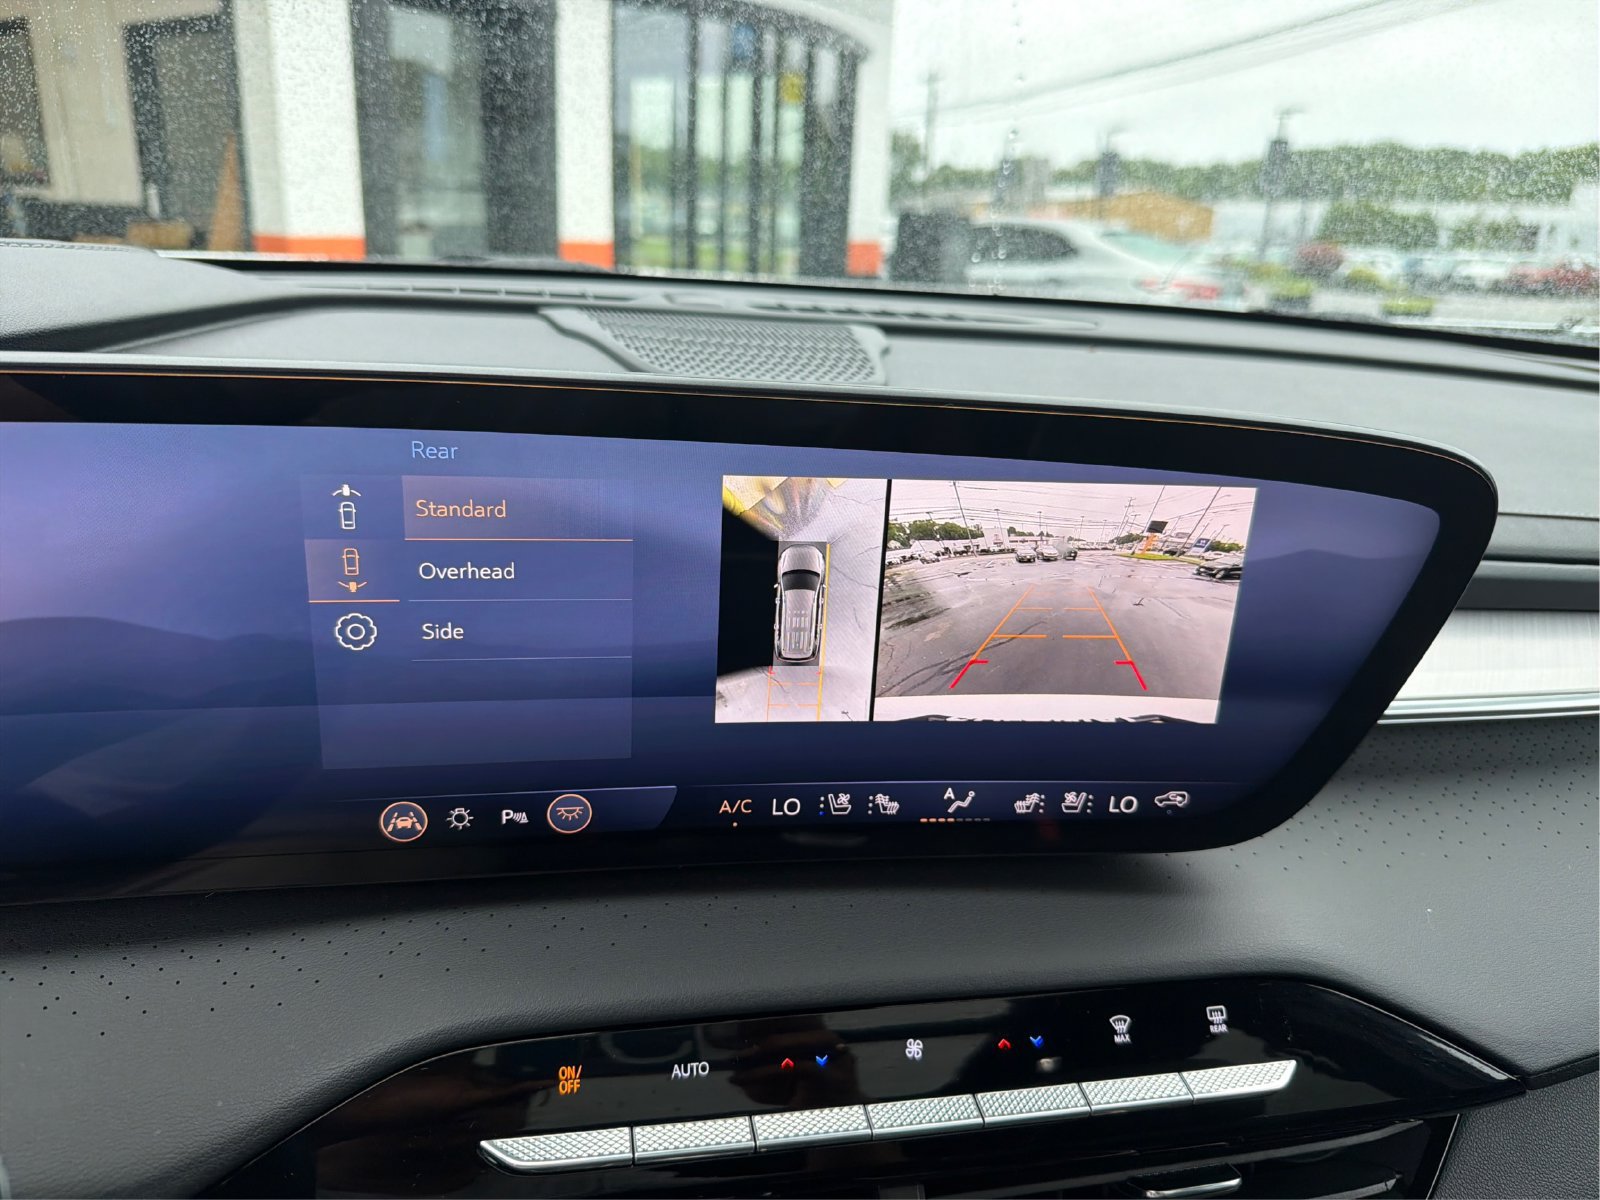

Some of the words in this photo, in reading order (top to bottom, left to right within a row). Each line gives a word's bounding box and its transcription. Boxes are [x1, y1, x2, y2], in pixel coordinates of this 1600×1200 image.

[411, 440, 459, 460] Rear
[415, 499, 507, 519] Standard
[418, 562, 516, 580] Overhead
[421, 622, 465, 640] Side
[718, 799, 753, 814] A/C
[772, 797, 801, 816] LO
[1108, 795, 1139, 813] LO
[1209, 1024, 1228, 1034] REAR
[1113, 1034, 1131, 1044] MAX
[558, 1065, 582, 1080] ON/
[671, 1061, 710, 1079] AUTO
[558, 1079, 581, 1095] OFF
